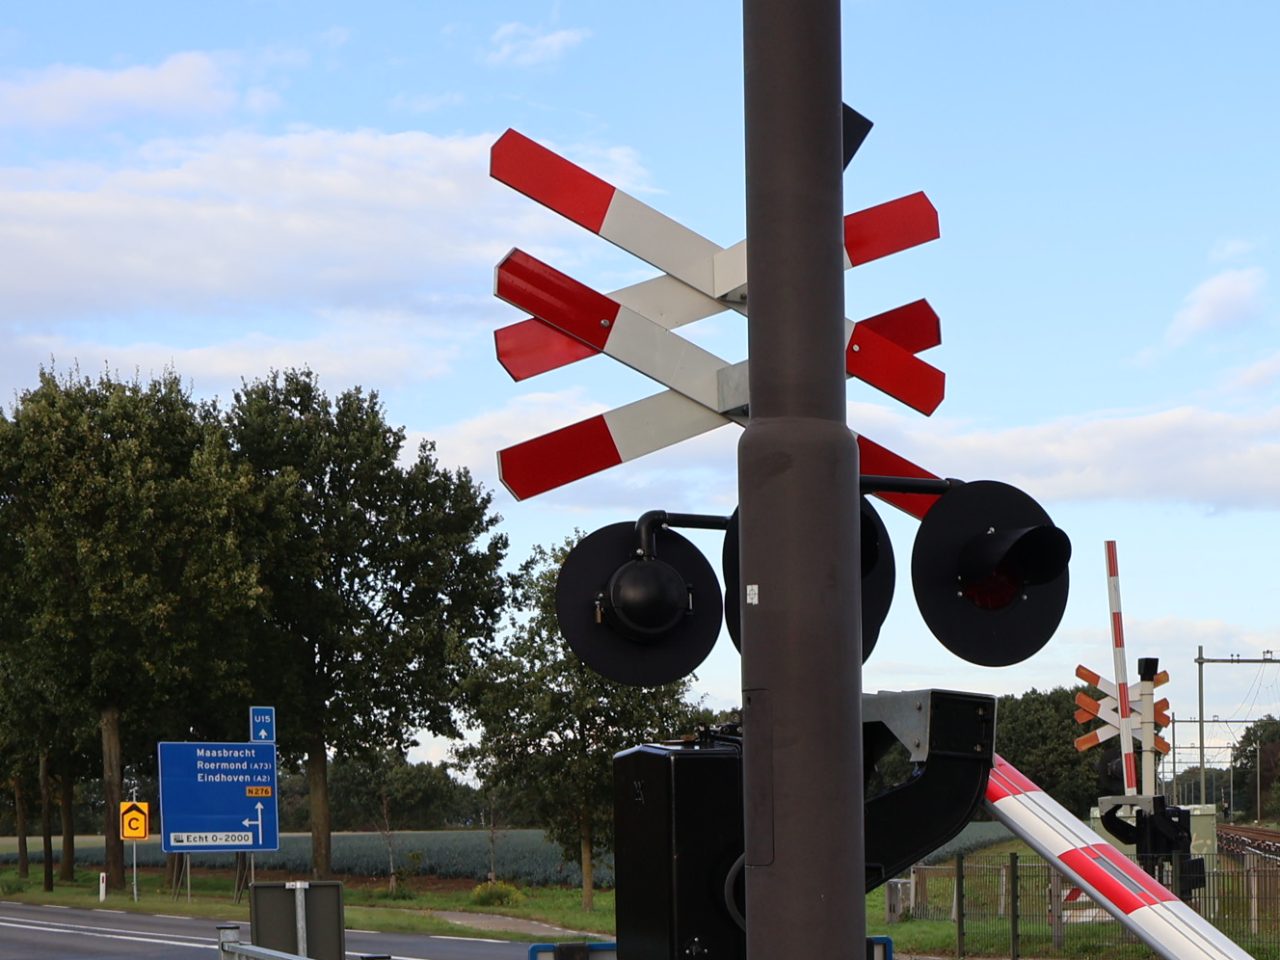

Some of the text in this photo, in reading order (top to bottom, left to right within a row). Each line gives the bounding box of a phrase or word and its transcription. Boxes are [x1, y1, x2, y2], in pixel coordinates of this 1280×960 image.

[255, 715, 271, 723] U15
[196, 748, 256, 758] Maasbracht
[196, 760, 272, 770] Roermond (A73)
[197, 773, 251, 782] Eindhoven
[248, 788, 270, 796] N276
[128, 817, 140, 831] C
[186, 834, 250, 843] Echt 0-2000
